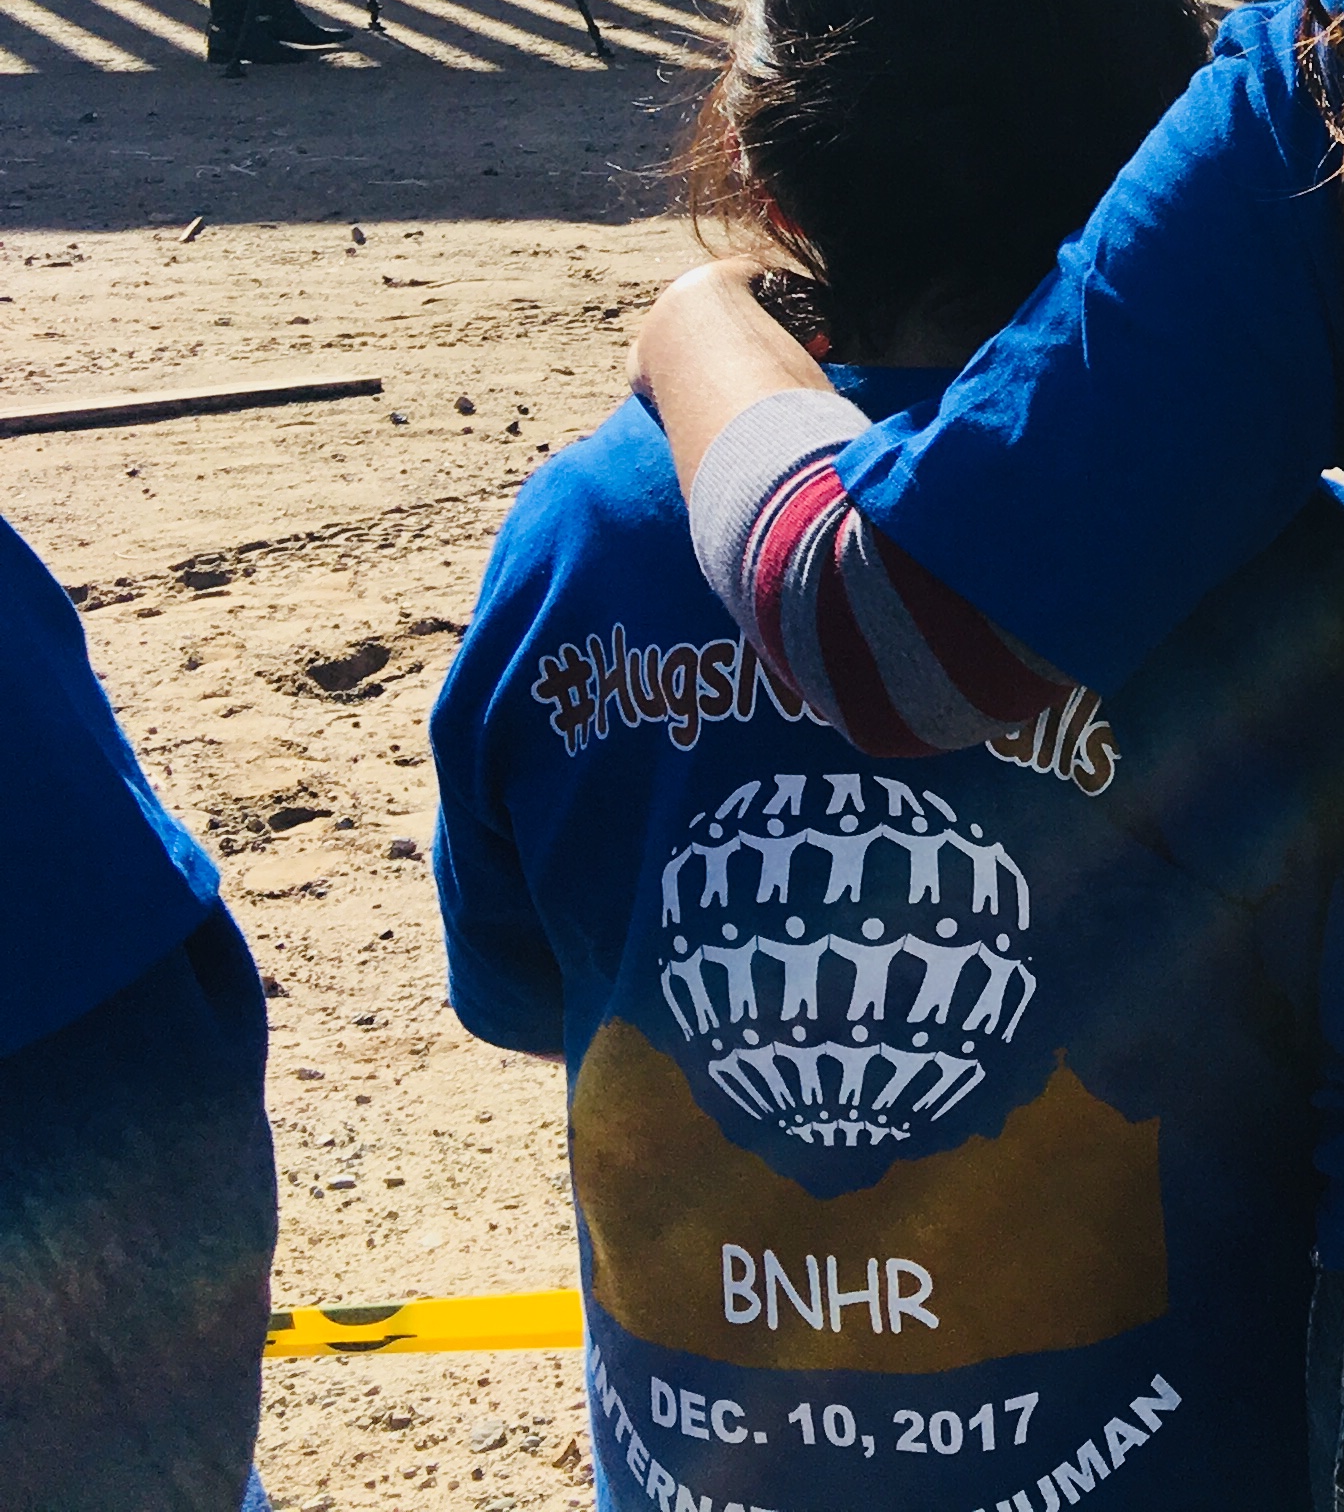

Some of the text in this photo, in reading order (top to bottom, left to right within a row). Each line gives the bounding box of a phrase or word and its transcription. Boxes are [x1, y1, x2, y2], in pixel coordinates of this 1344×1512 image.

[722, 1243, 940, 1335] BNHR
[651, 1376, 1039, 1458] DEC. 10, 2017
[973, 1373, 1182, 1512] UMAN
